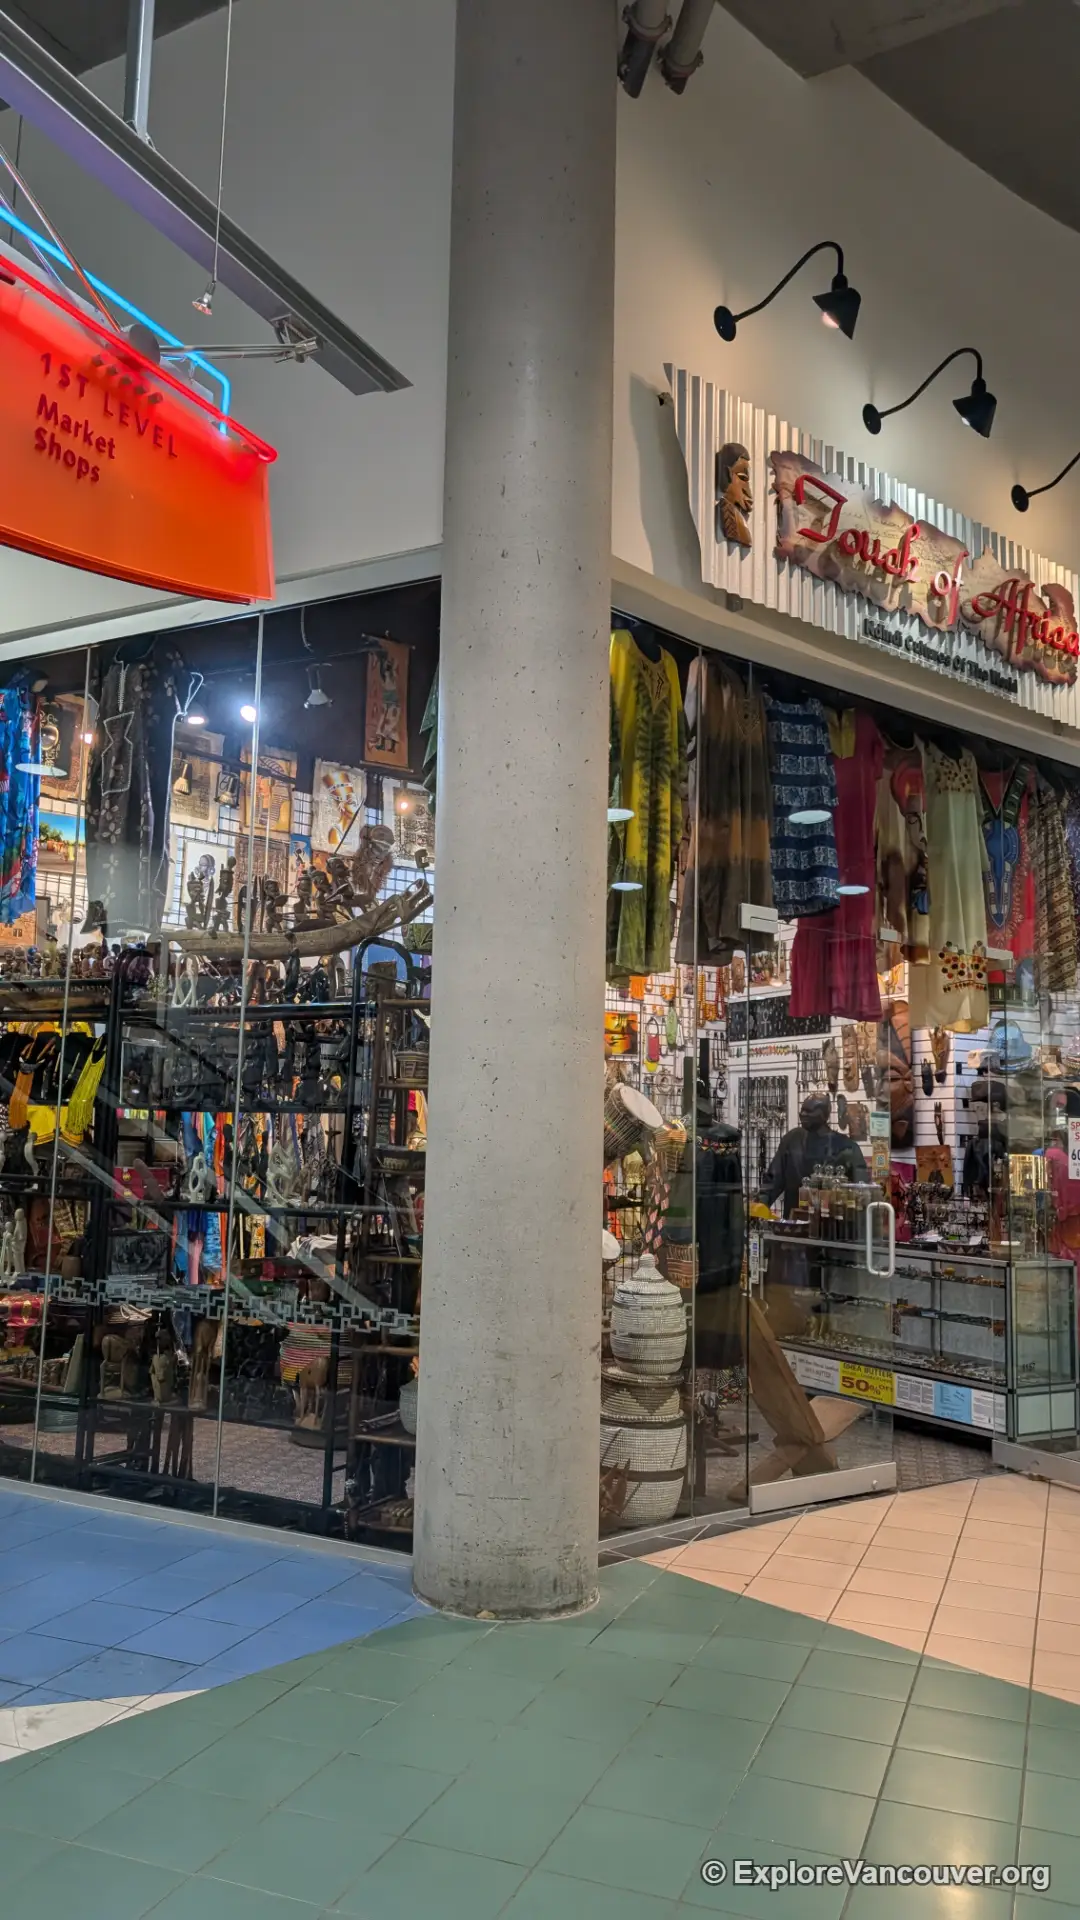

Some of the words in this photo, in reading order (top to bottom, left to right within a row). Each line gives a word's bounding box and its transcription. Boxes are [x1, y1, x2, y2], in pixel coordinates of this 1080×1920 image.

[37, 393, 116, 460] Market
[40, 352, 90, 399] 1ST
[103, 393, 178, 458] LEVEL
[34, 426, 101, 483] Shops
[794, 474, 921, 583] Touch
[930, 550, 969, 626] of
[971, 578, 1080, 656] Africa
[841, 1375, 881, 1396] 50%
